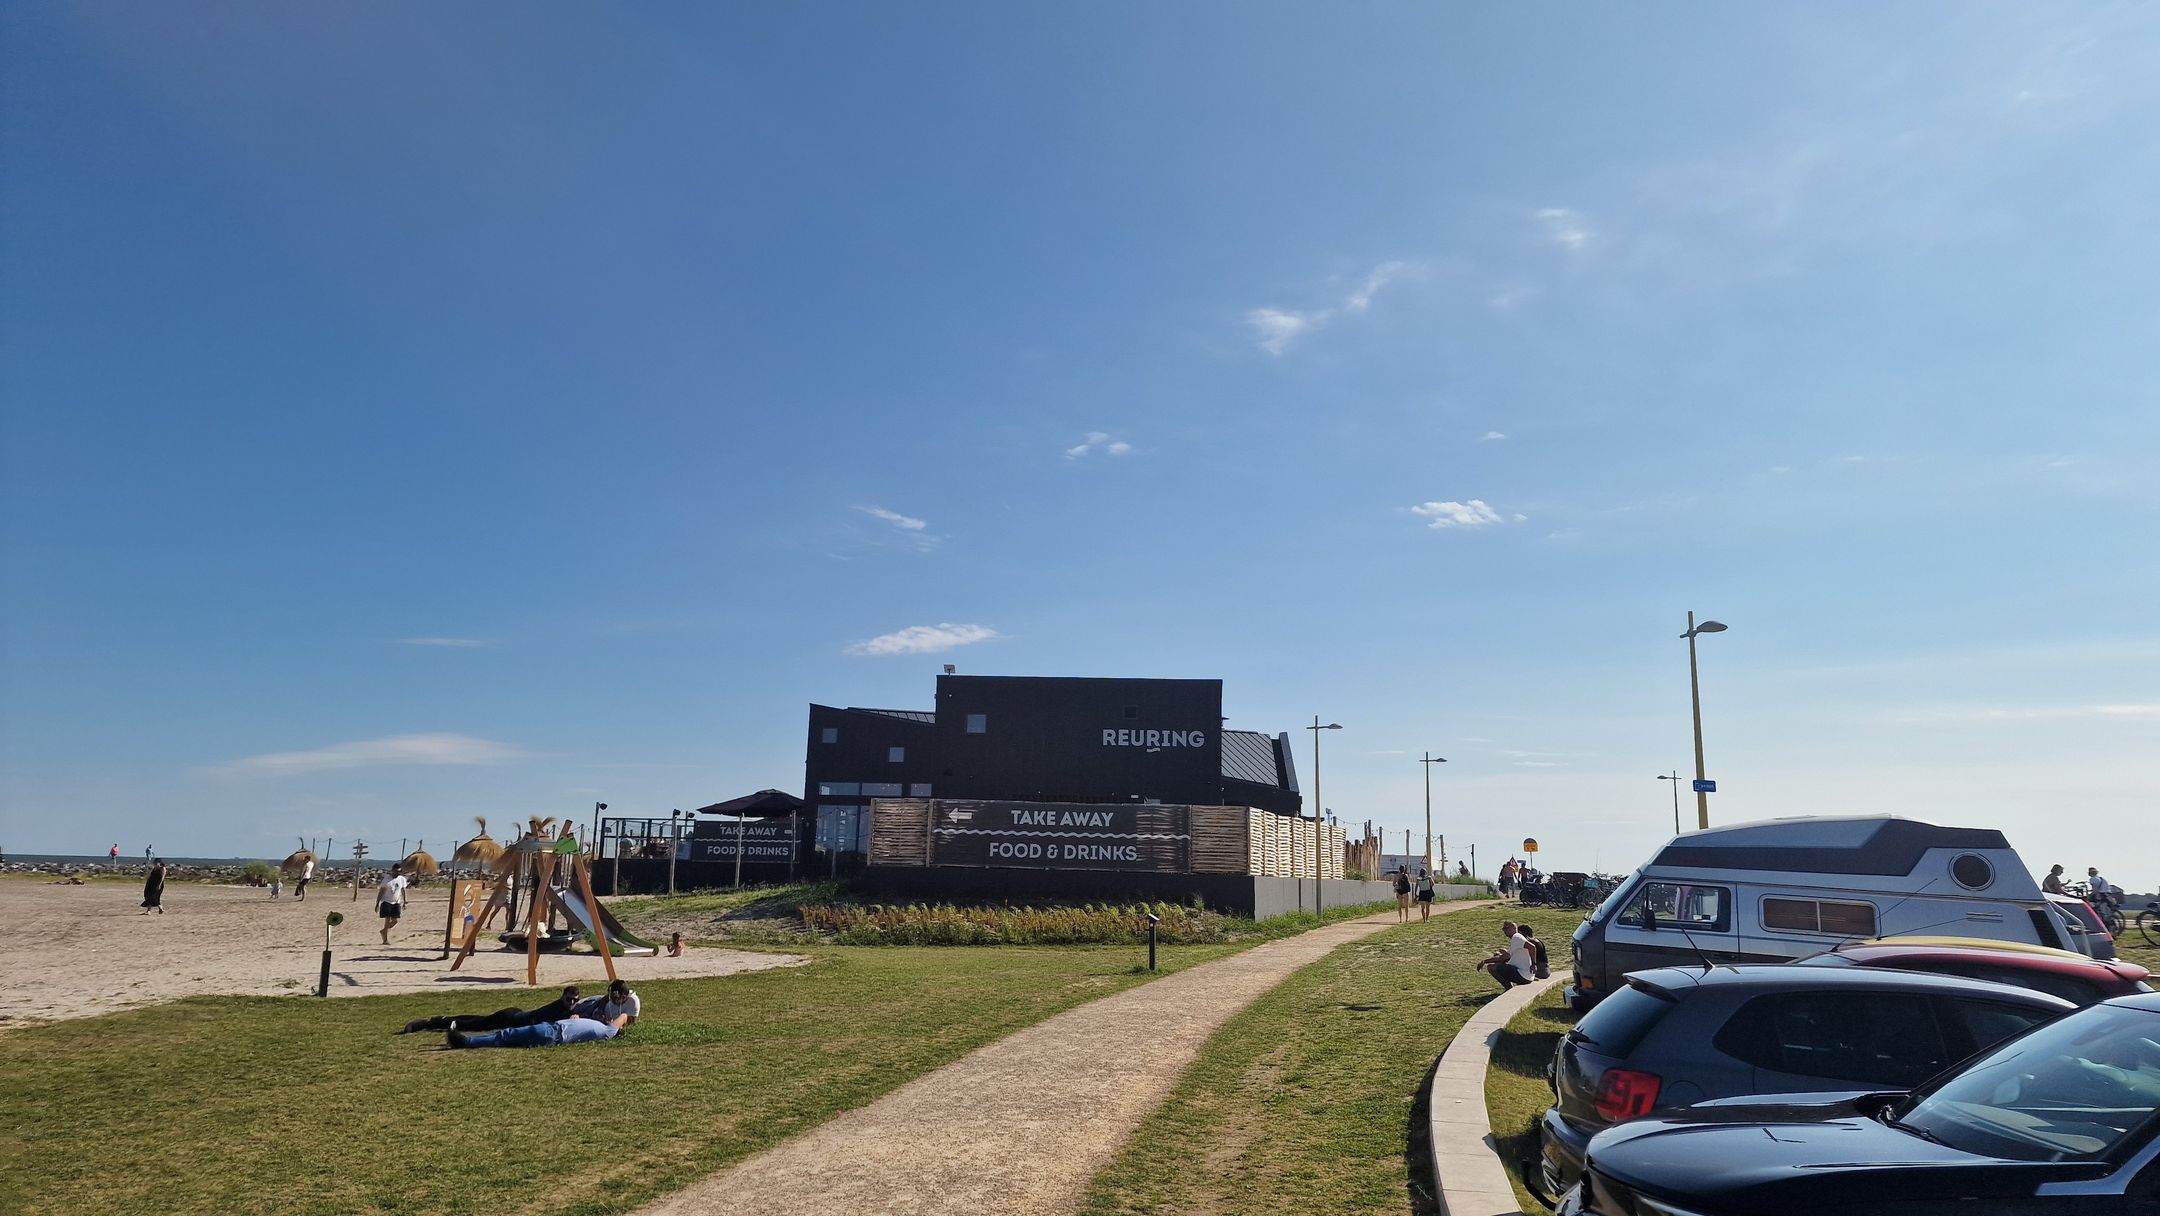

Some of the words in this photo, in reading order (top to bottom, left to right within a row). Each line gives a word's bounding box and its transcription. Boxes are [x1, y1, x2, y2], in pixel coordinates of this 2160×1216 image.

[1102, 729, 1205, 748] REURING
[1011, 810, 1056, 826] TAKE
[1059, 811, 1114, 827] AWAY
[720, 826, 745, 836] TAKE
[747, 827, 777, 836] AWAY
[707, 846, 736, 855] FOOD
[748, 847, 789, 856] DRINKS
[989, 843, 1042, 859] FOOD
[1046, 844, 1059, 859] &
[1063, 844, 1138, 861] DRINKS
